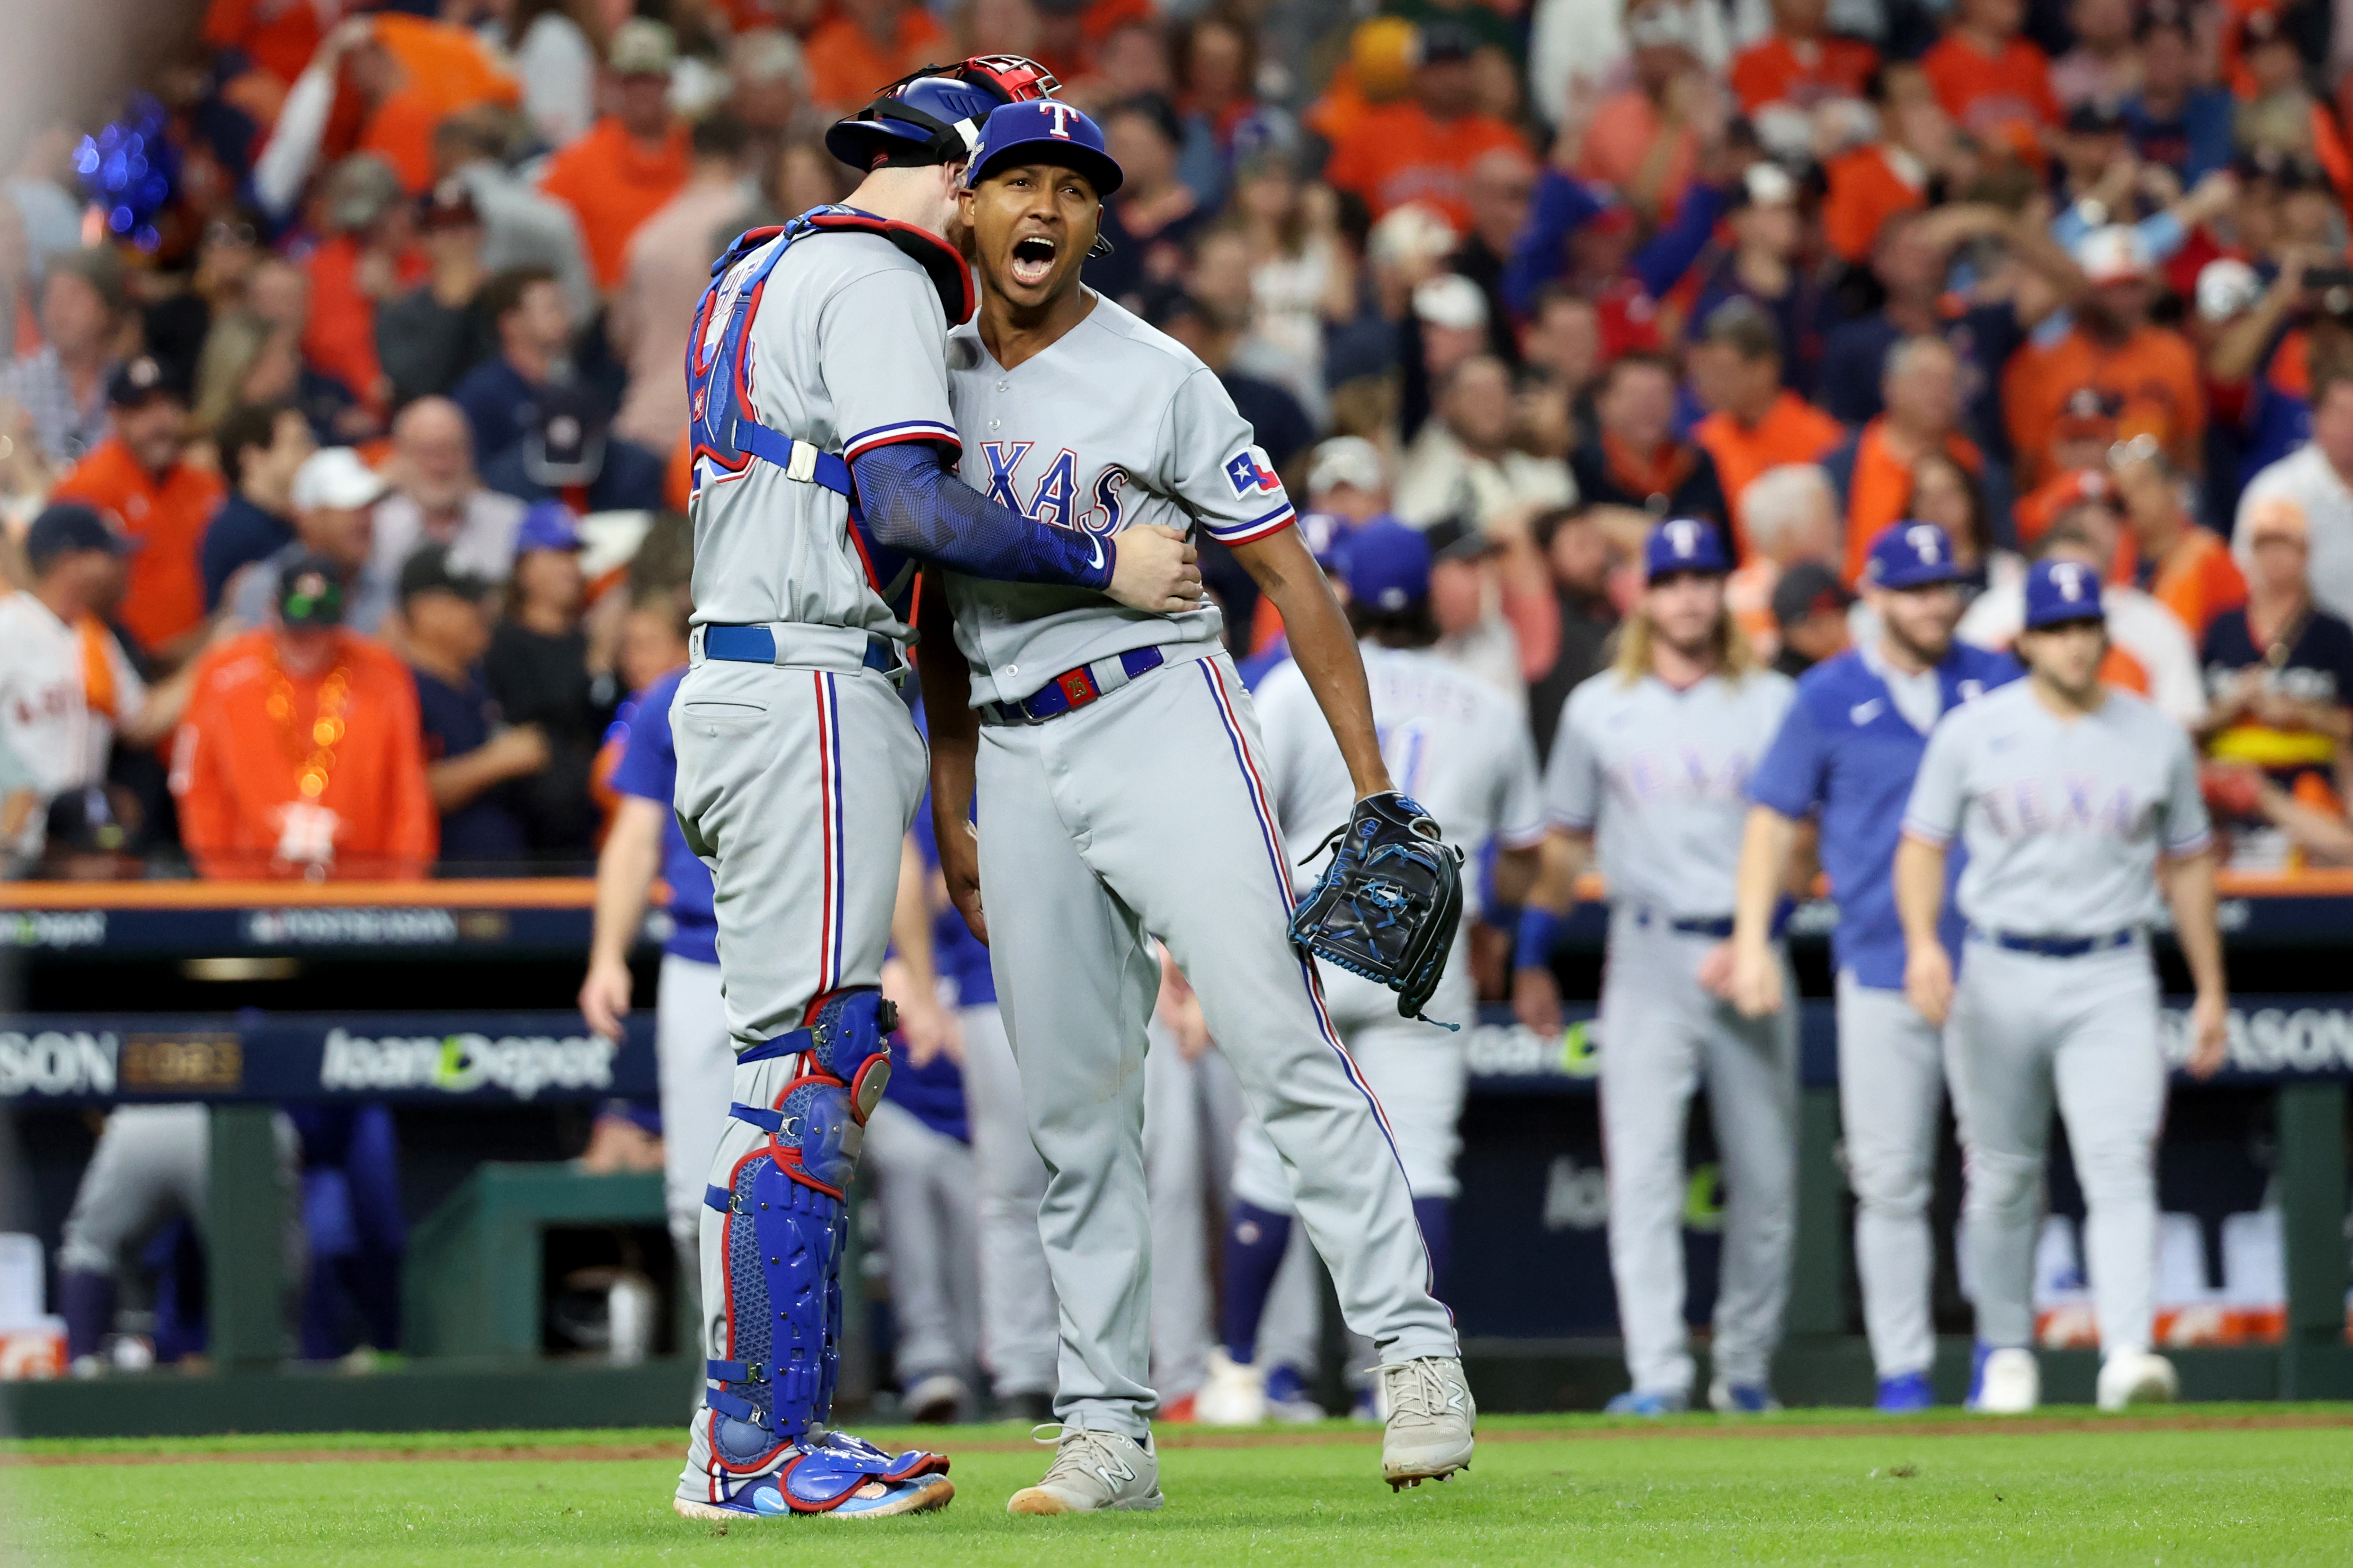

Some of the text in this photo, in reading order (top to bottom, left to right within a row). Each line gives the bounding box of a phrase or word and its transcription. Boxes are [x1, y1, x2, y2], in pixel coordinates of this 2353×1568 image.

[1039, 102, 1079, 140] T
[980, 441, 1130, 537] XAS
[1663, 519, 1701, 559] T
[1067, 677, 1088, 699] 25
[1608, 739, 1753, 808] TEXA
[1981, 771, 2137, 837] TEXA
[1329, 847, 1356, 886] LIAM
[321, 1028, 616, 1100] loanDepot
